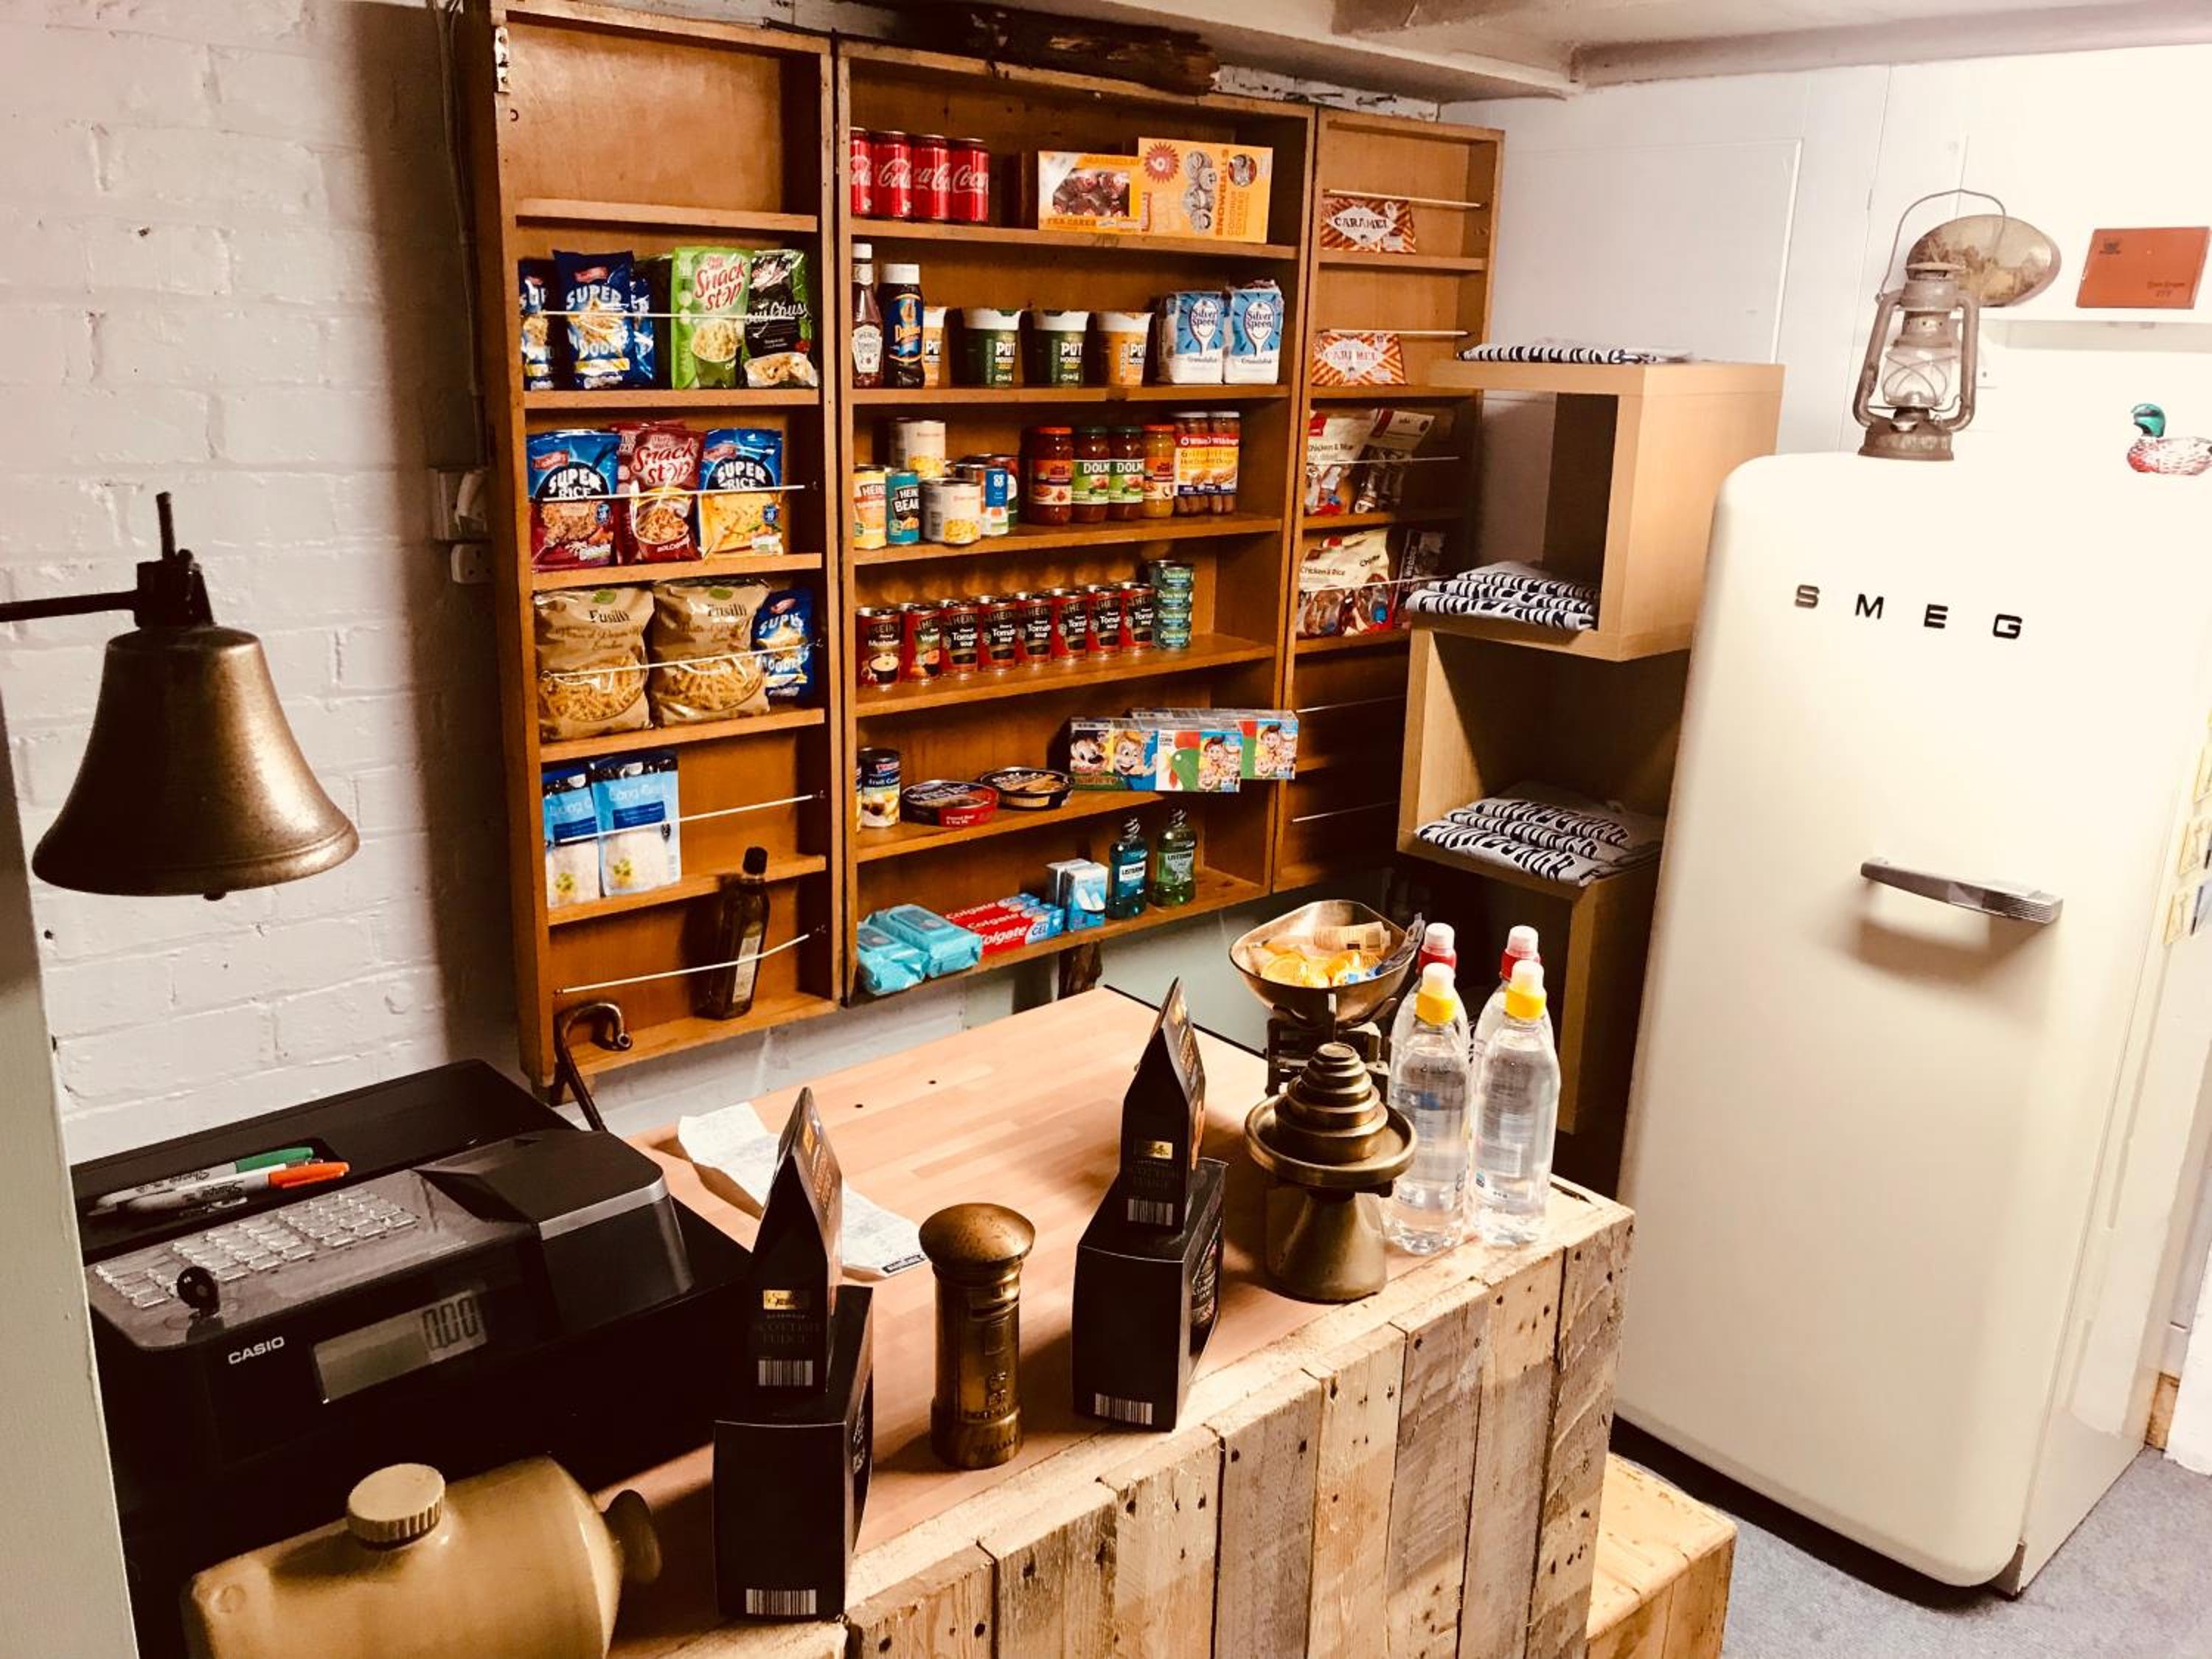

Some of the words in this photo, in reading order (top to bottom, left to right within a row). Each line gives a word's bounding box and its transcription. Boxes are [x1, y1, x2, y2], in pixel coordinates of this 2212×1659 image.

[1216, 148, 1229, 236] SNOWBALLS
[1334, 217, 1389, 229] CARAMEL
[694, 260, 745, 299] Snack
[1192, 310, 1217, 320] Silver
[1246, 310, 1273, 321] Silver
[631, 437, 695, 473] Snack
[549, 467, 602, 495] SUPER
[717, 461, 766, 484] SUPER
[589, 609, 630, 622] Fusilli
[1795, 584, 2023, 640] SMEG
[945, 902, 996, 920] Colgate
[967, 913, 1019, 930] Colgate
[227, 1335, 285, 1365] CASIO
